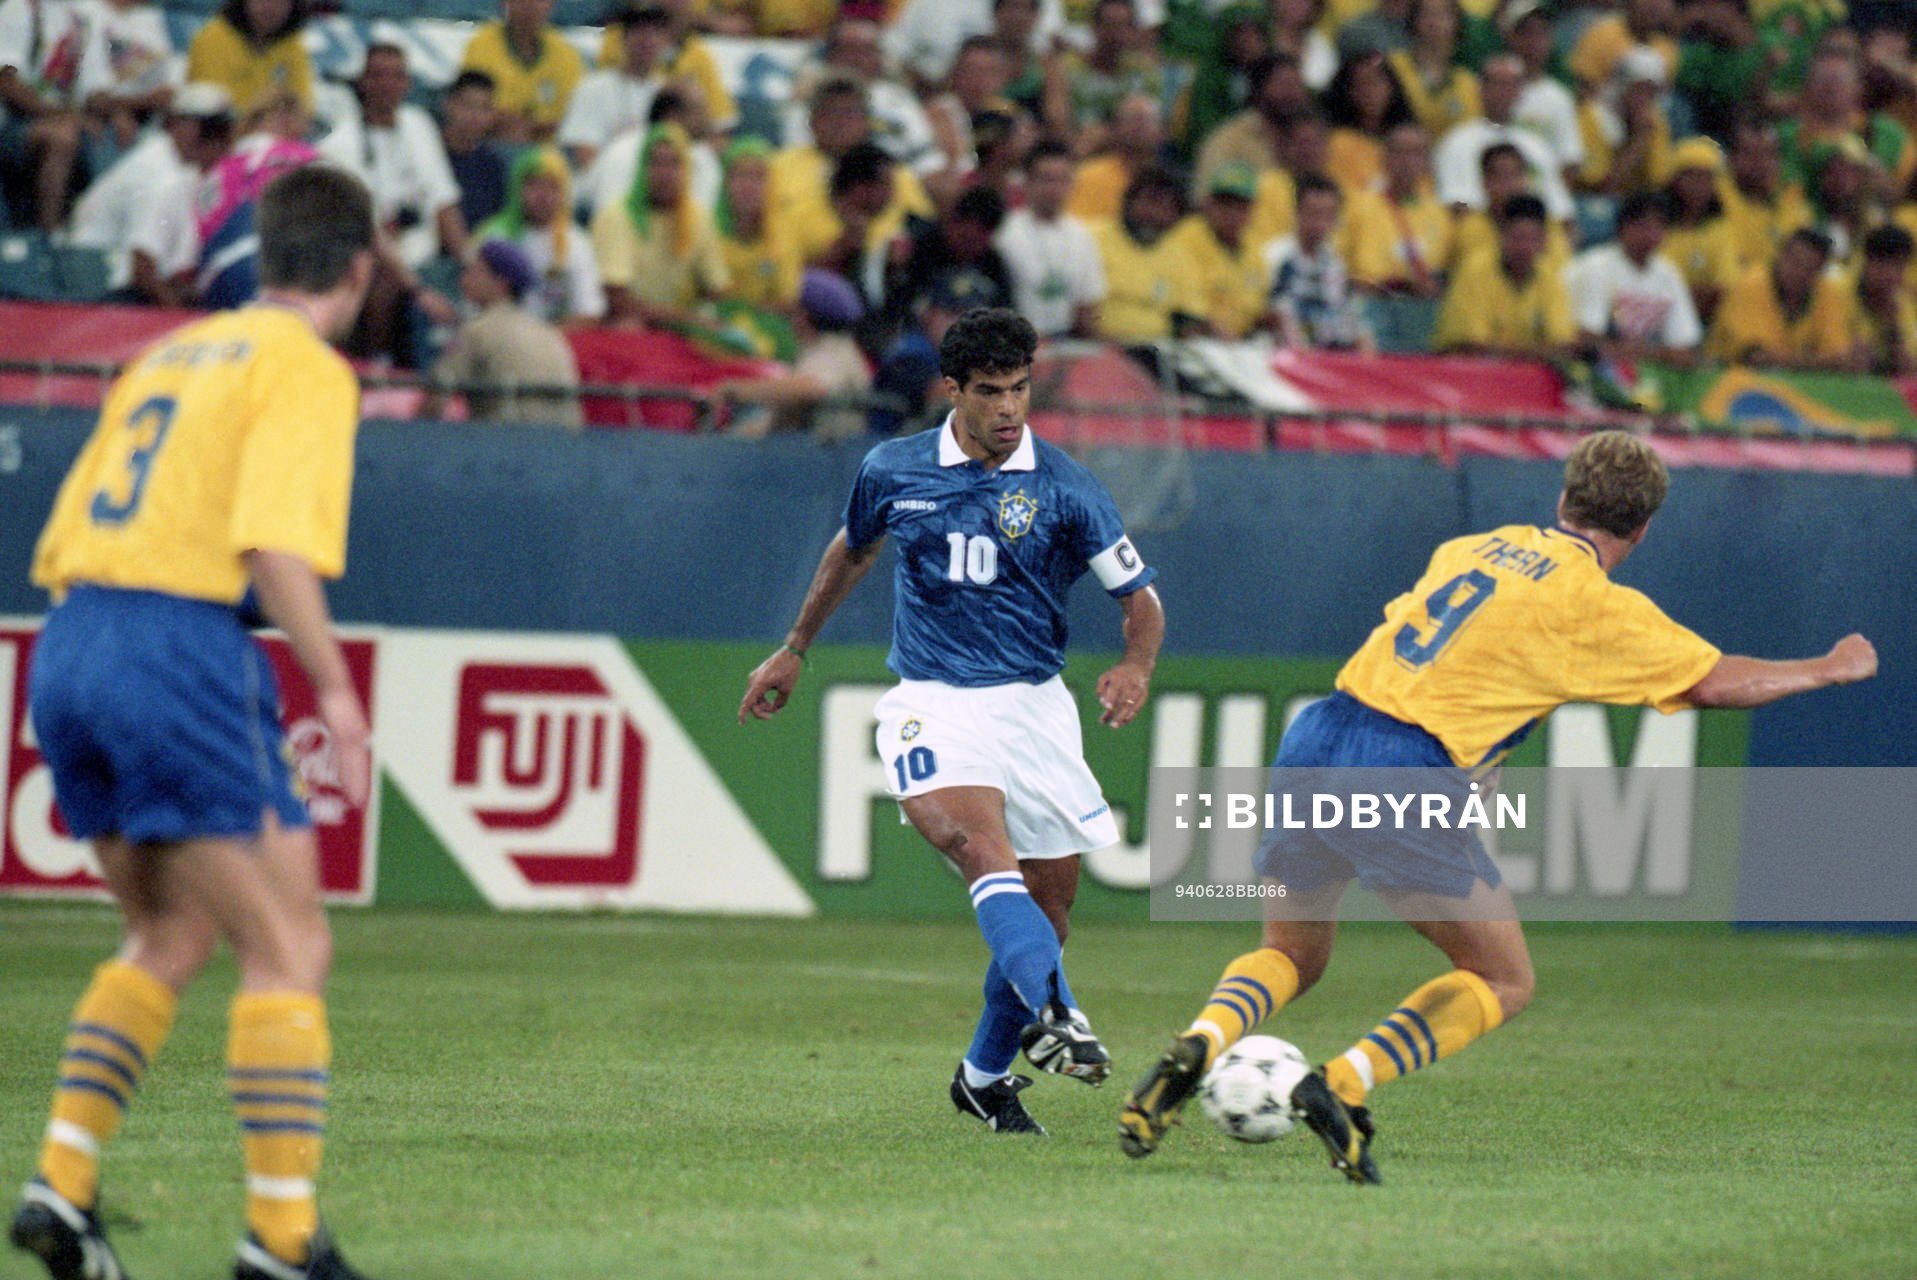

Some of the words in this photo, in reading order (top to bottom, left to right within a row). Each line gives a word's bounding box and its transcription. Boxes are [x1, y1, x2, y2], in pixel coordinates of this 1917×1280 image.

[90, 394, 178, 526] 3
[892, 499, 937, 511] UMBRO
[946, 531, 998, 585] 10
[1114, 542, 1137, 571] C
[1393, 568, 1497, 674] 9
[894, 746, 938, 793] 10
[1079, 804, 1108, 823] UMBRO
